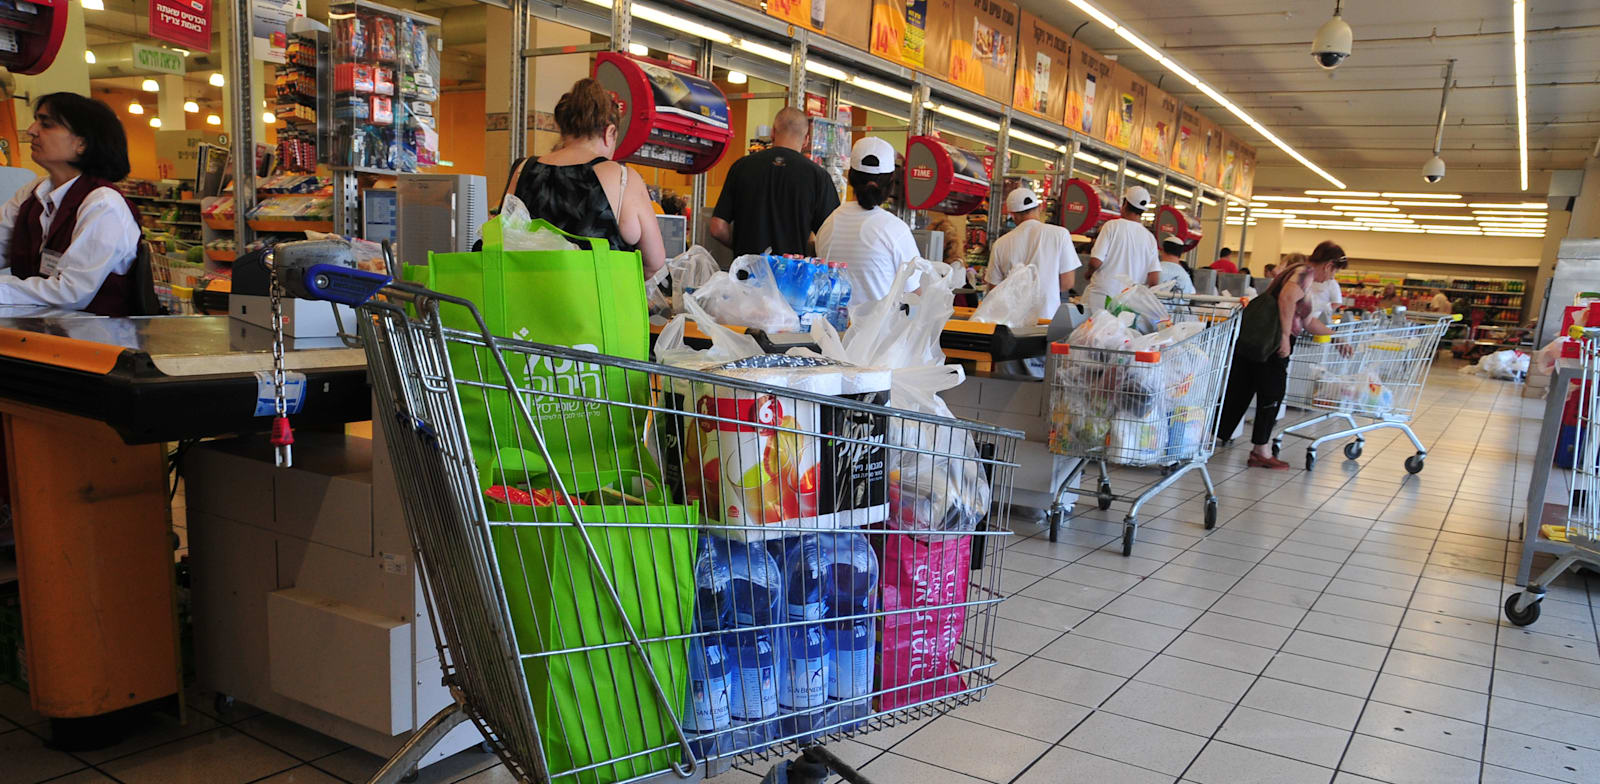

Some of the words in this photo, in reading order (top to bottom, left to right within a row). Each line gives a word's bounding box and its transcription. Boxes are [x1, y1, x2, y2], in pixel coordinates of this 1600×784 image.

[157, 4, 180, 16] שאתה
[161, 13, 180, 25] צריך!
[181, 12, 206, 26] הכרטיס
[181, 20, 202, 32] באמת
[876, 22, 889, 53] 14
[912, 169, 931, 178] TIME
[523, 373, 600, 414] הירוק
[536, 401, 580, 413] שופרסל
[760, 400, 773, 424] 6
